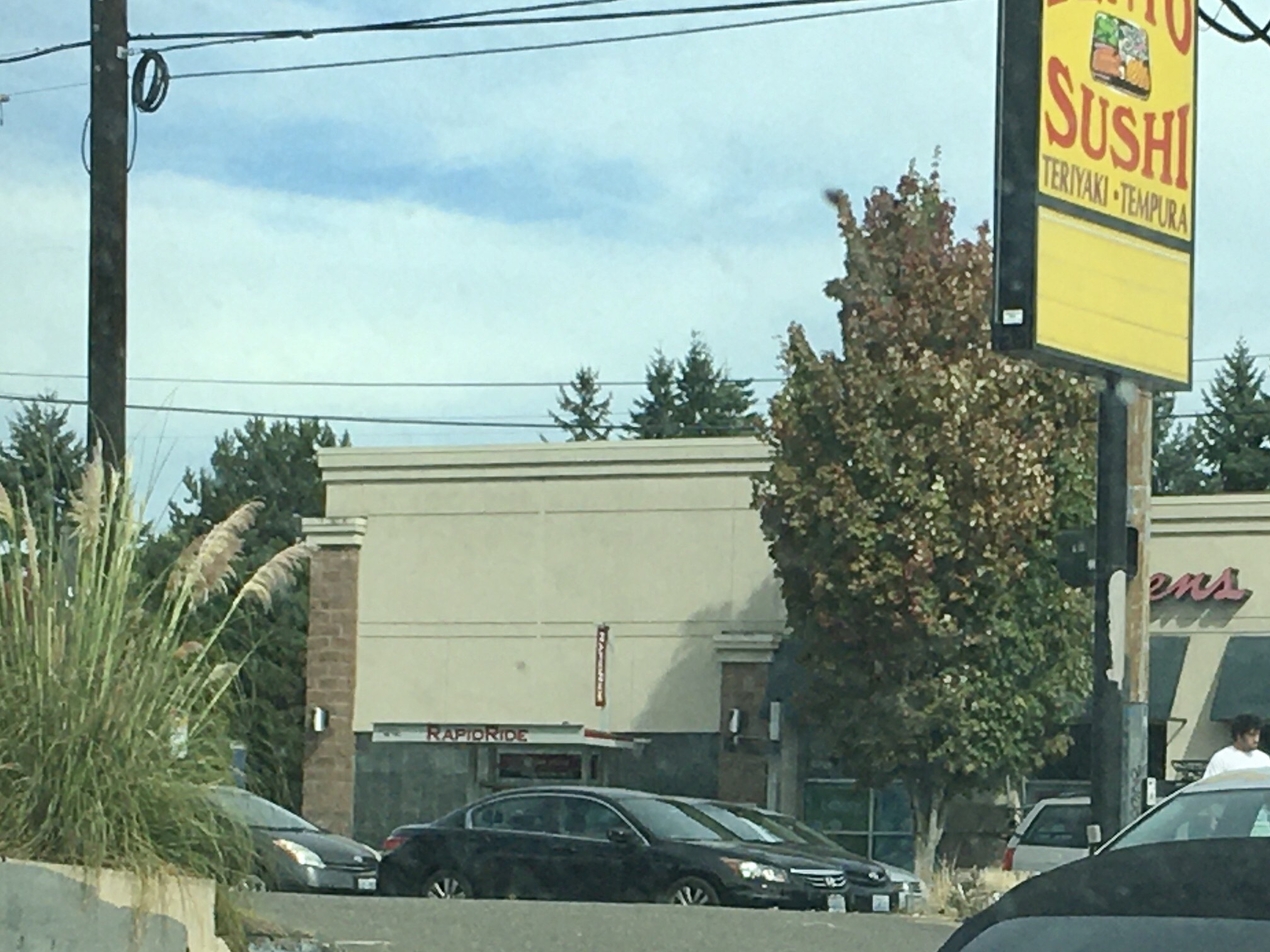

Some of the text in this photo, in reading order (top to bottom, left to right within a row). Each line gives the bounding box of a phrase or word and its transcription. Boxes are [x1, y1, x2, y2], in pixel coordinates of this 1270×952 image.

[1045, 55, 1189, 190] SUSHI
[1042, 155, 1188, 234] TERIYAKI TEMPURA
